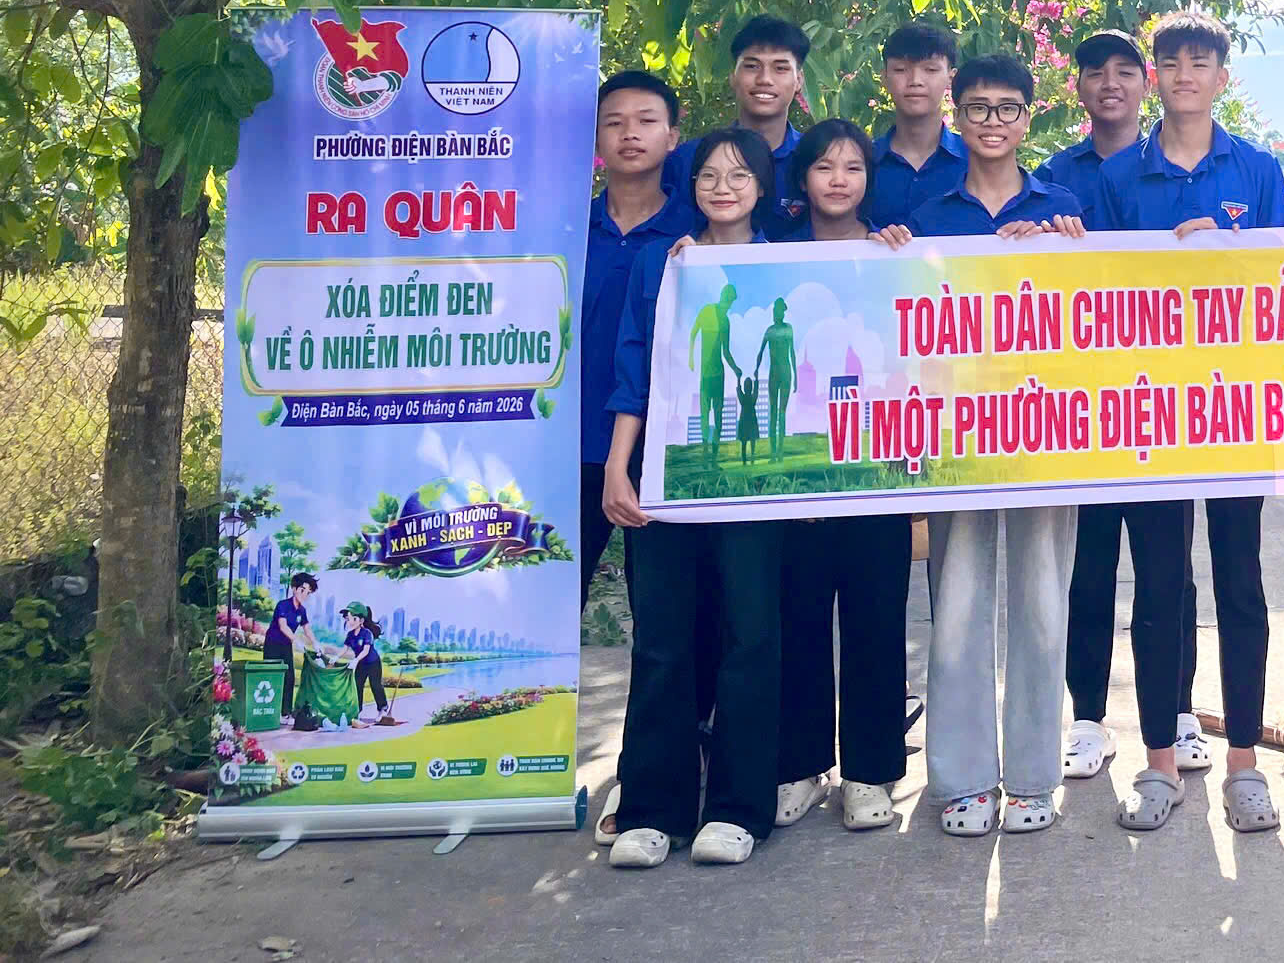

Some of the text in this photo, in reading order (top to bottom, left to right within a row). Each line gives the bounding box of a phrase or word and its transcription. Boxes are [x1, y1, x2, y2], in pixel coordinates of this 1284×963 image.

[439, 85, 504, 96] THANH NIÊN
[472, 98, 495, 106] NAM
[315, 128, 512, 161] PHƯỜNG ĐIỆN BÀN BẮC
[307, 181, 516, 238] RA QUÂN
[325, 269, 494, 319] XÓA ĐIỂM ĐEN
[895, 283, 983, 358] TOÀN
[994, 280, 1061, 353] DÂN
[1072, 289, 1183, 351] CHUNG
[1191, 287, 1244, 345] TAY
[265, 323, 551, 371] VỀ Ô NHIỄM MÔI TRƯỜNG
[291, 396, 524, 422] Điện Bàn Bắc, ngày 05 tháng 6 năm 2026
[828, 387, 860, 462] VÌ
[871, 384, 945, 473] MỘT
[954, 377, 1090, 456] PHƯỜNG
[1098, 374, 1177, 462] ĐIỆN
[1186, 371, 1255, 445] BÀN
[390, 532, 428, 553] XANH
[439, 525, 475, 546] SẠCH
[486, 521, 513, 539] ĐẸP
[404, 505, 499, 536] VÌ MÔI TRƯỜNG
